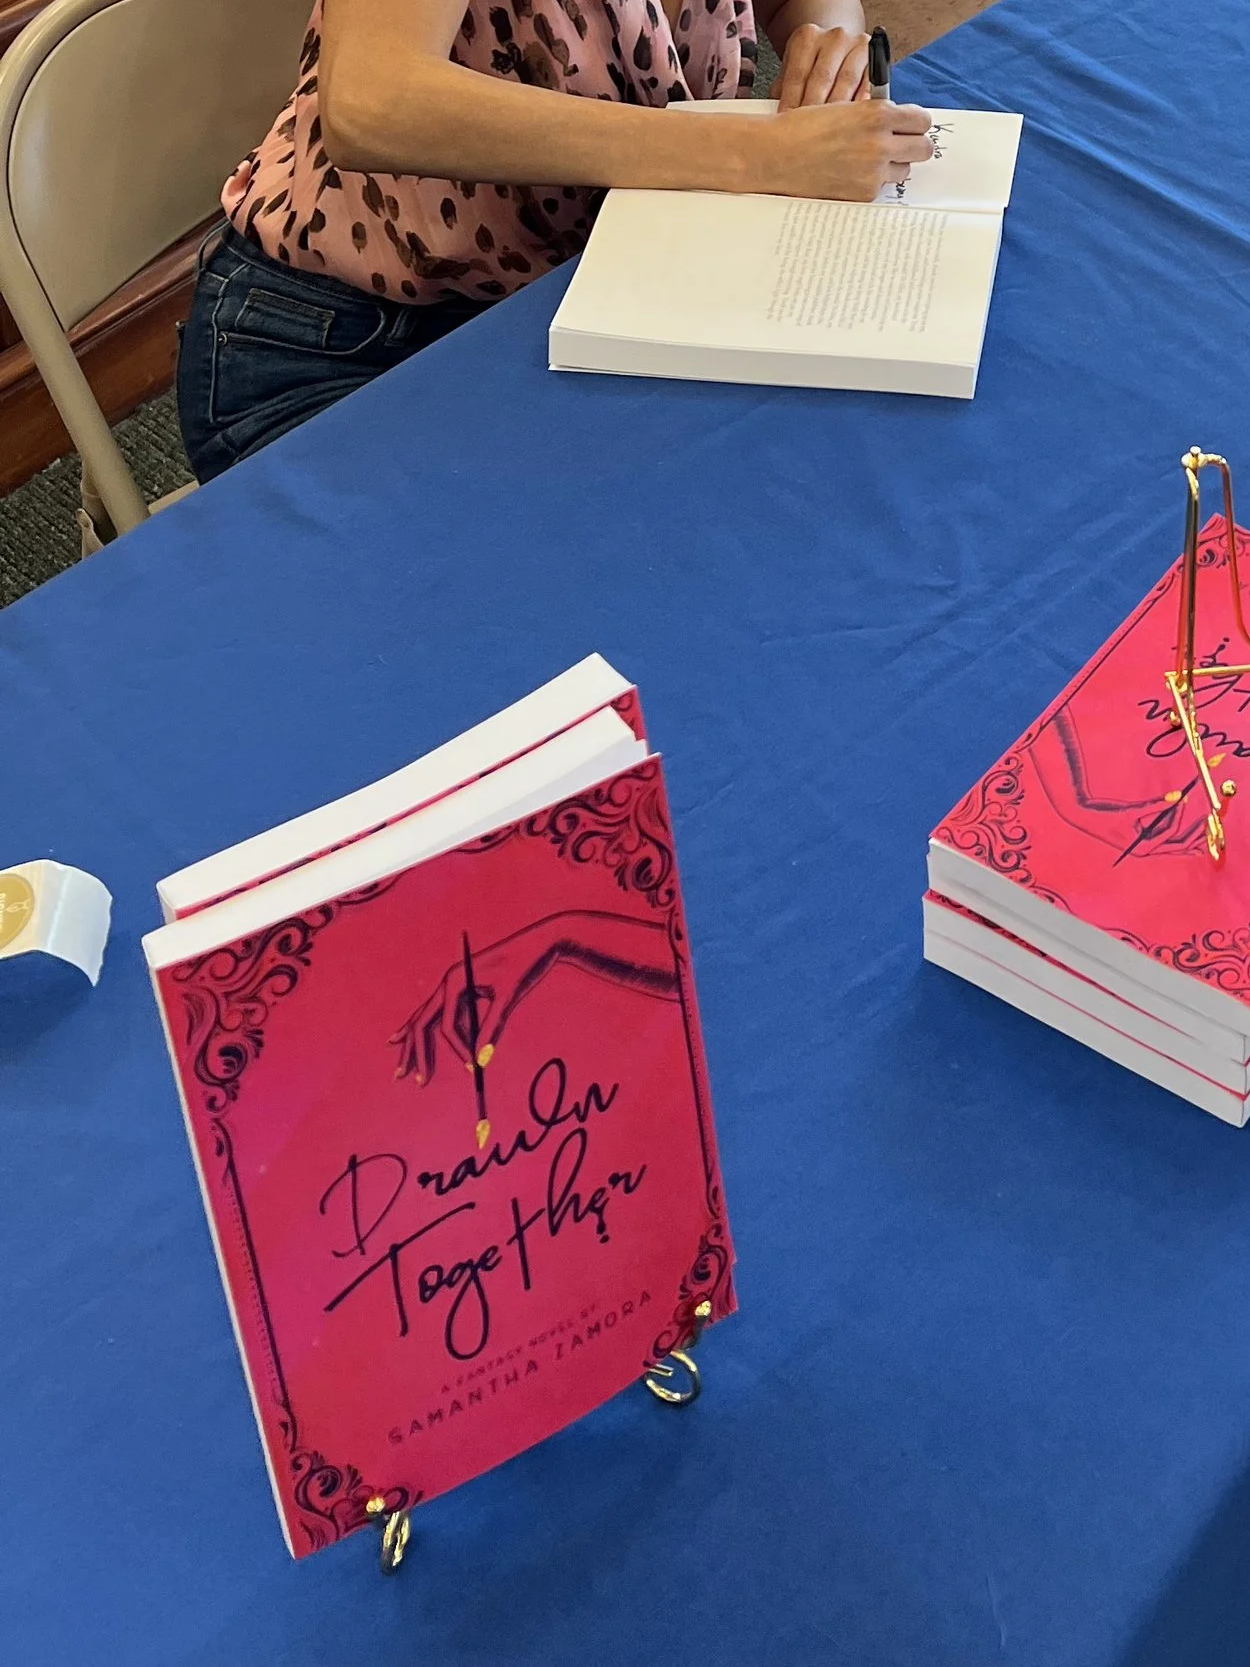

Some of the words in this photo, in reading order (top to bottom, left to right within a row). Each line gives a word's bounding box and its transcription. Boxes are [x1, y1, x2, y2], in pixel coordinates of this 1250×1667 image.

[319, 1057, 620, 1259] Drawn
[323, 1126, 648, 1361] Together
[388, 1358, 539, 1444] SAMANTHA
[554, 1289, 652, 1361] ZAMORA
